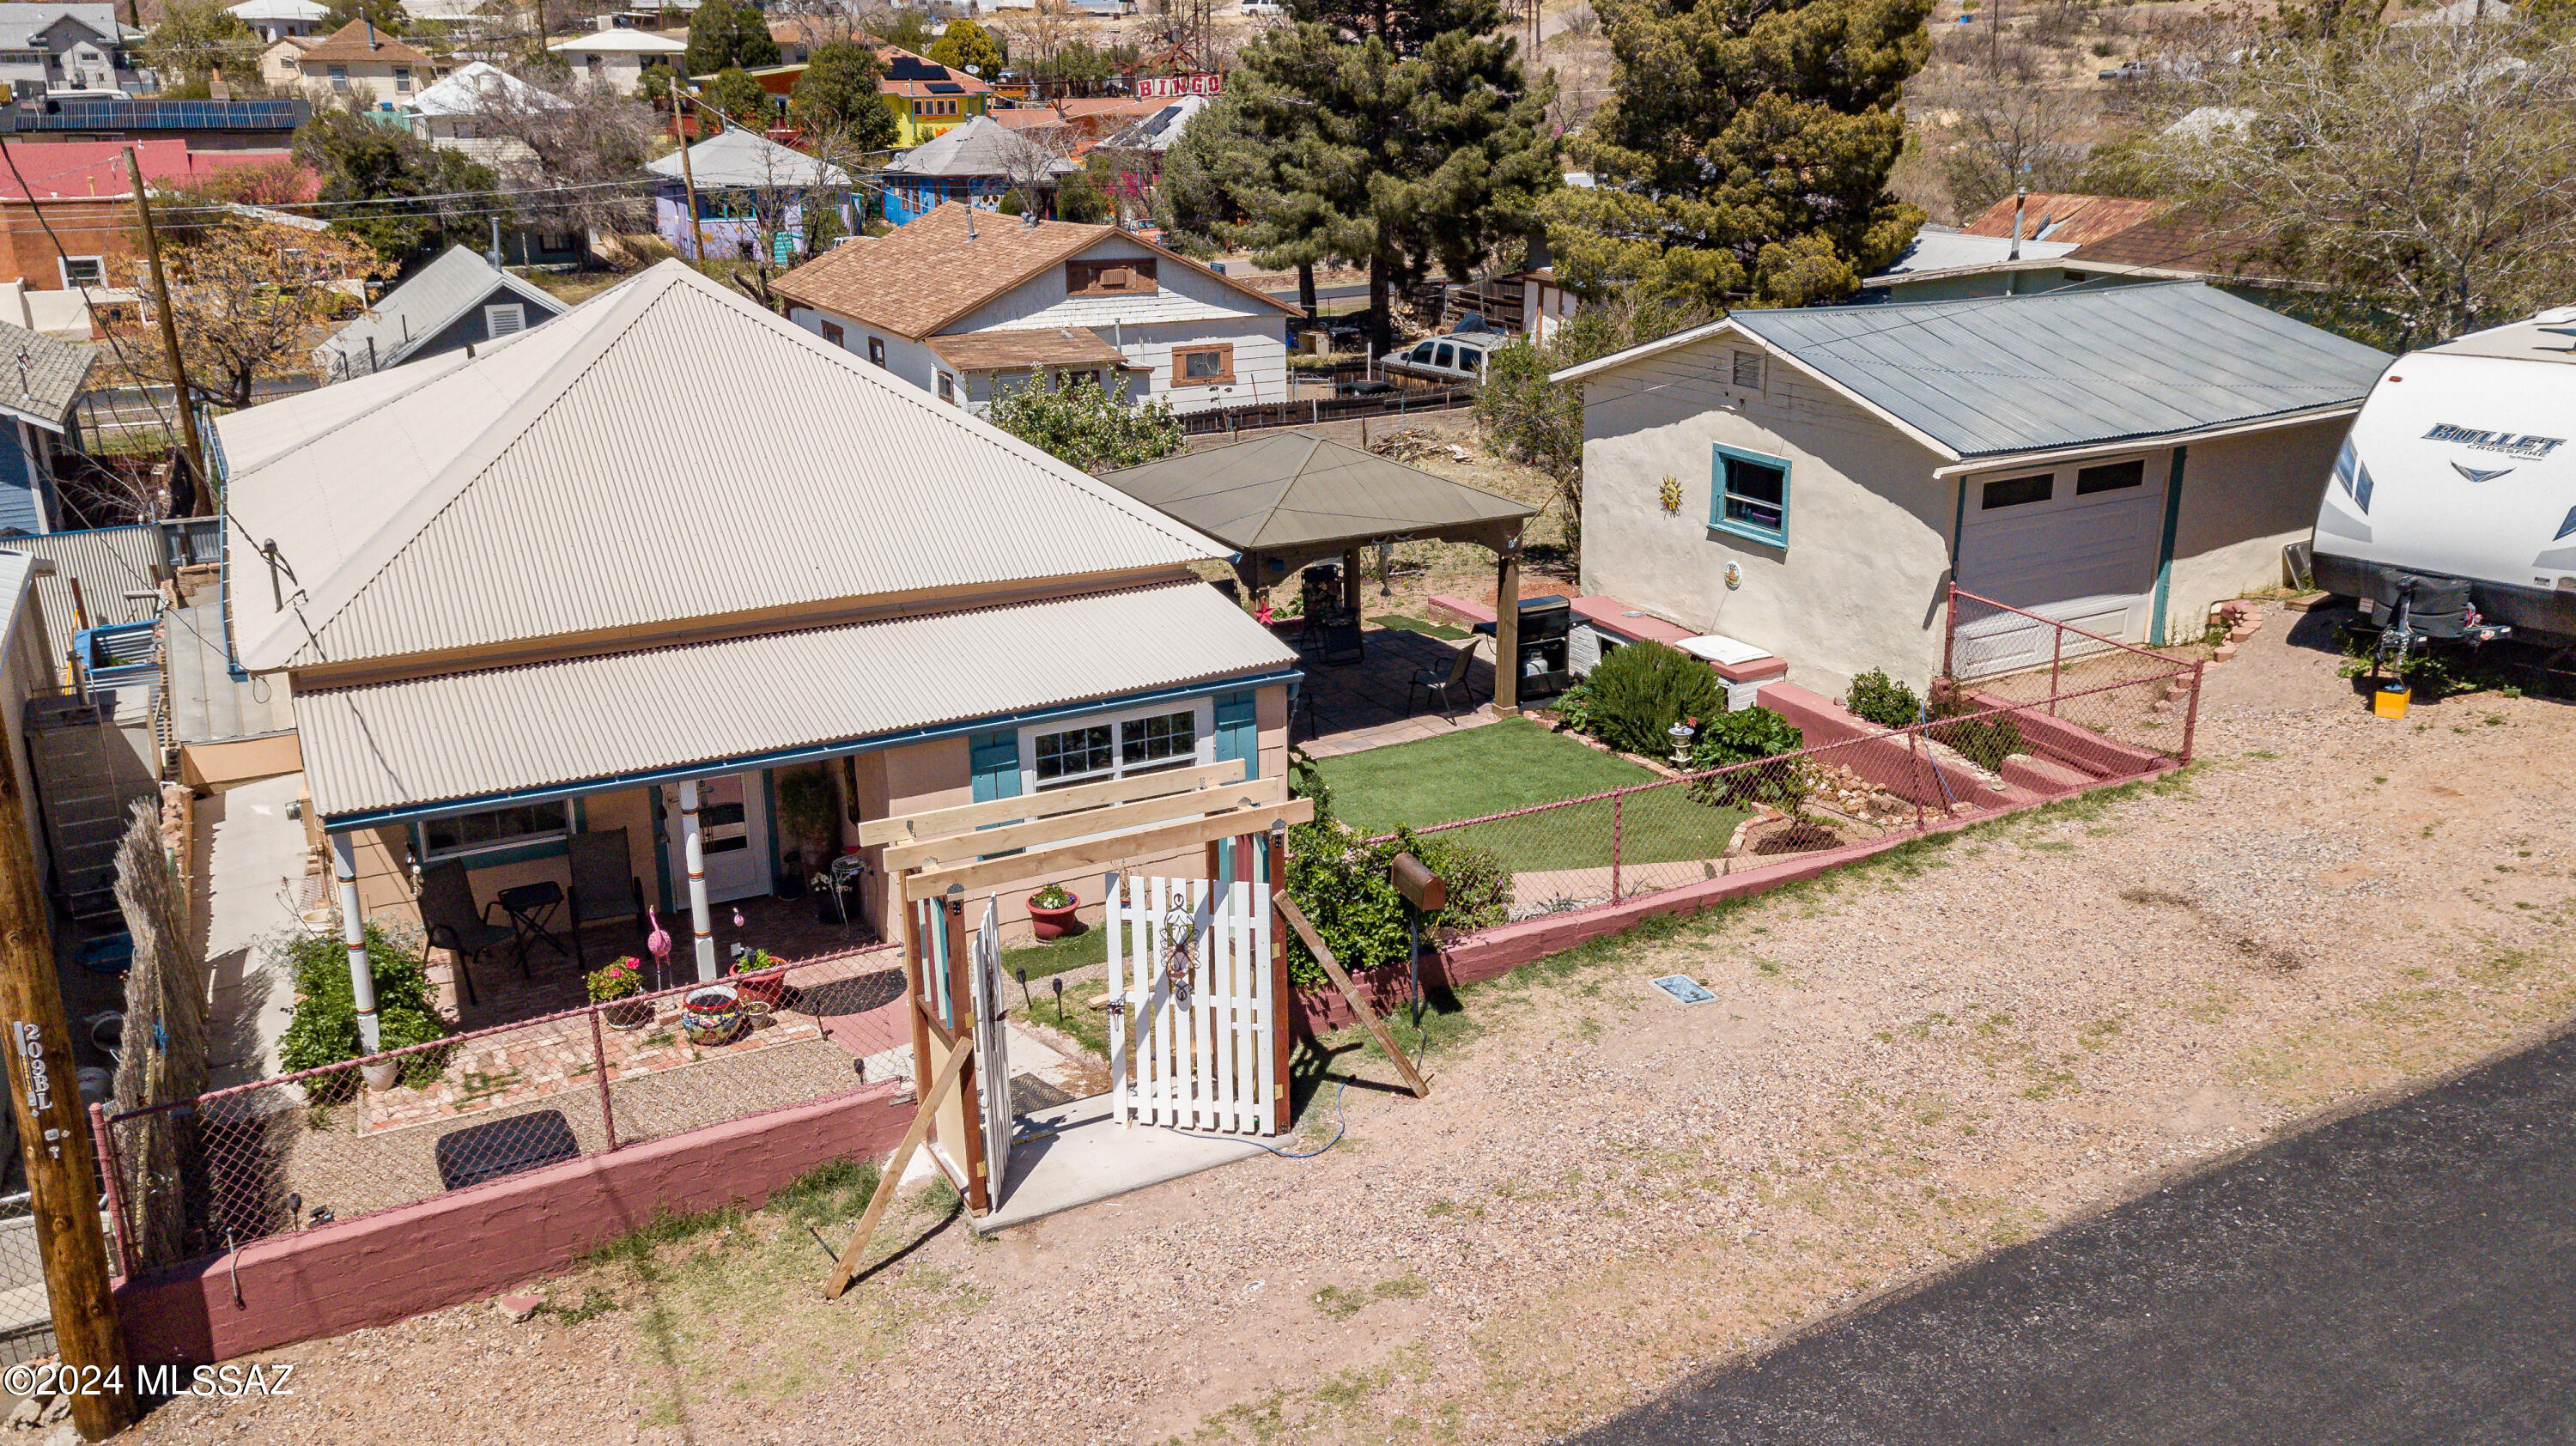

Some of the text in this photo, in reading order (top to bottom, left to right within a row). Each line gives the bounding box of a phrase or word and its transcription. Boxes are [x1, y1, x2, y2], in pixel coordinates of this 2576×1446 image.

[1139, 76, 1219, 96] BINGO
[2420, 423, 2567, 453] BULLET
[2467, 444, 2548, 458] CROSSFIRE
